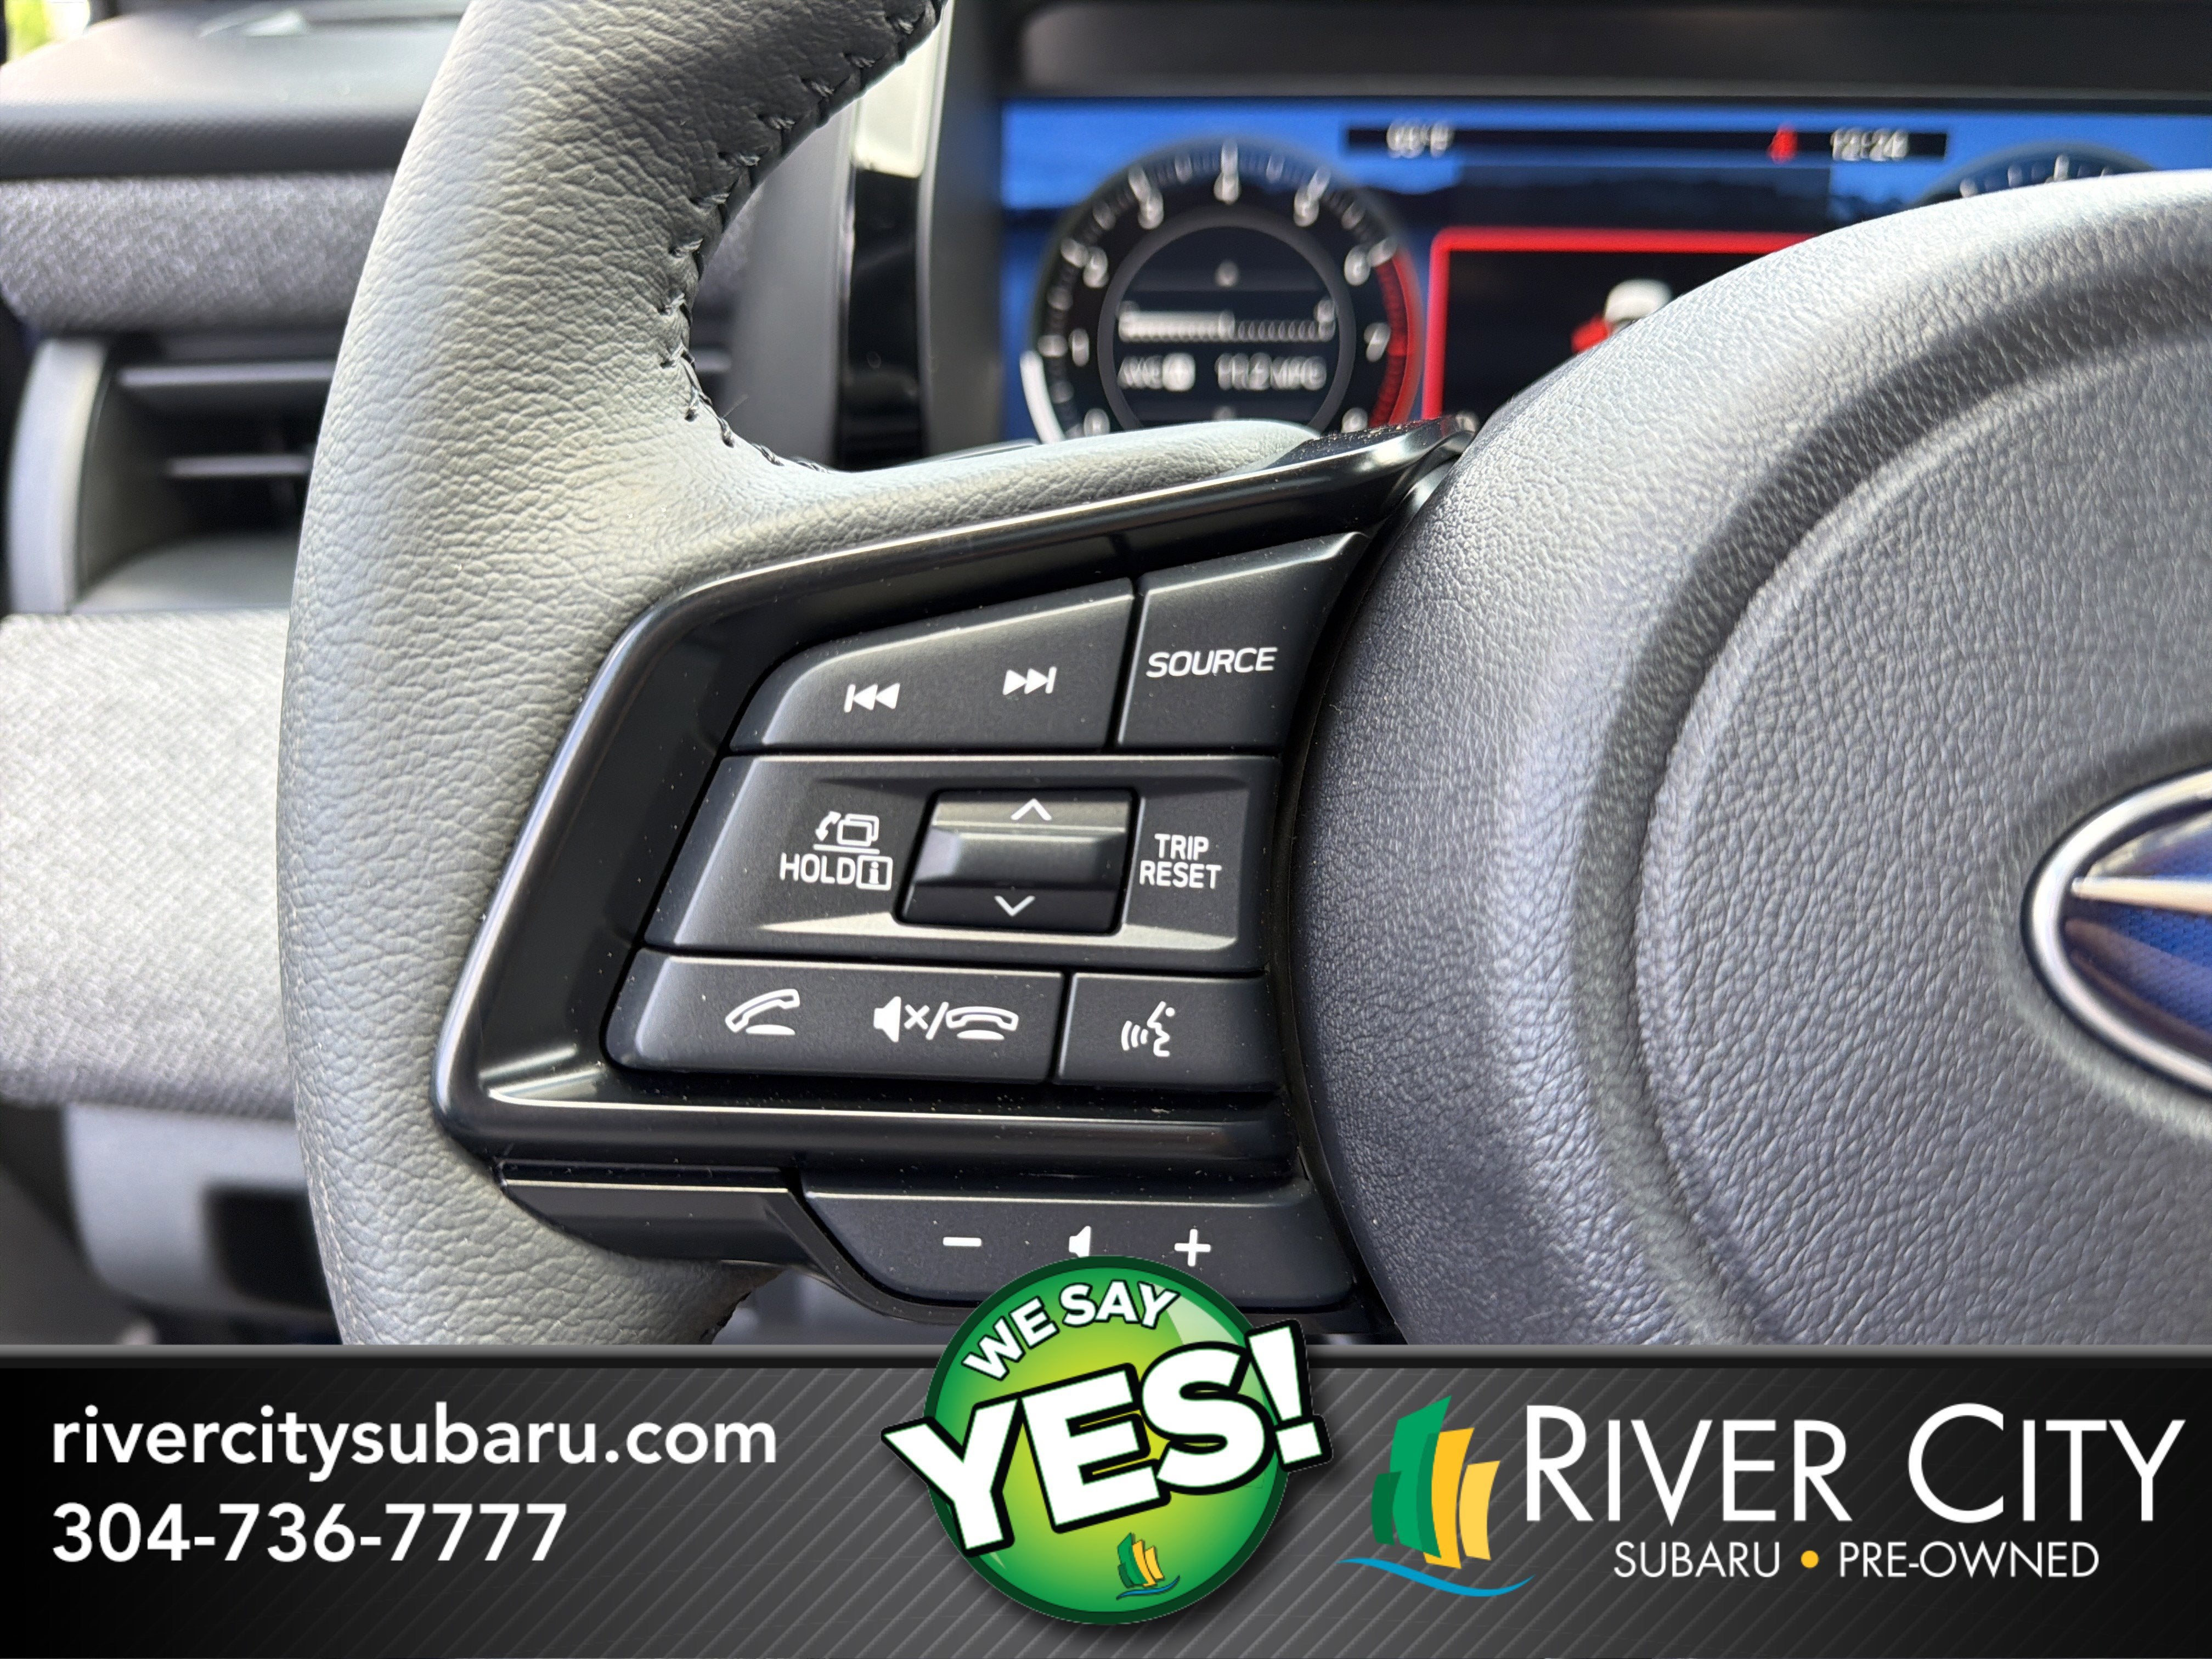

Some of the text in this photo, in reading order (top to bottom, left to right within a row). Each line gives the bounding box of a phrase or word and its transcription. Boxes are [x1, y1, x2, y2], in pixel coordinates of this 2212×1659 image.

[1146, 647, 1278, 679] SOURCE
[1154, 833, 1210, 860] TRIP
[779, 852, 856, 885] HOLD
[1138, 859, 1223, 889] RESET
